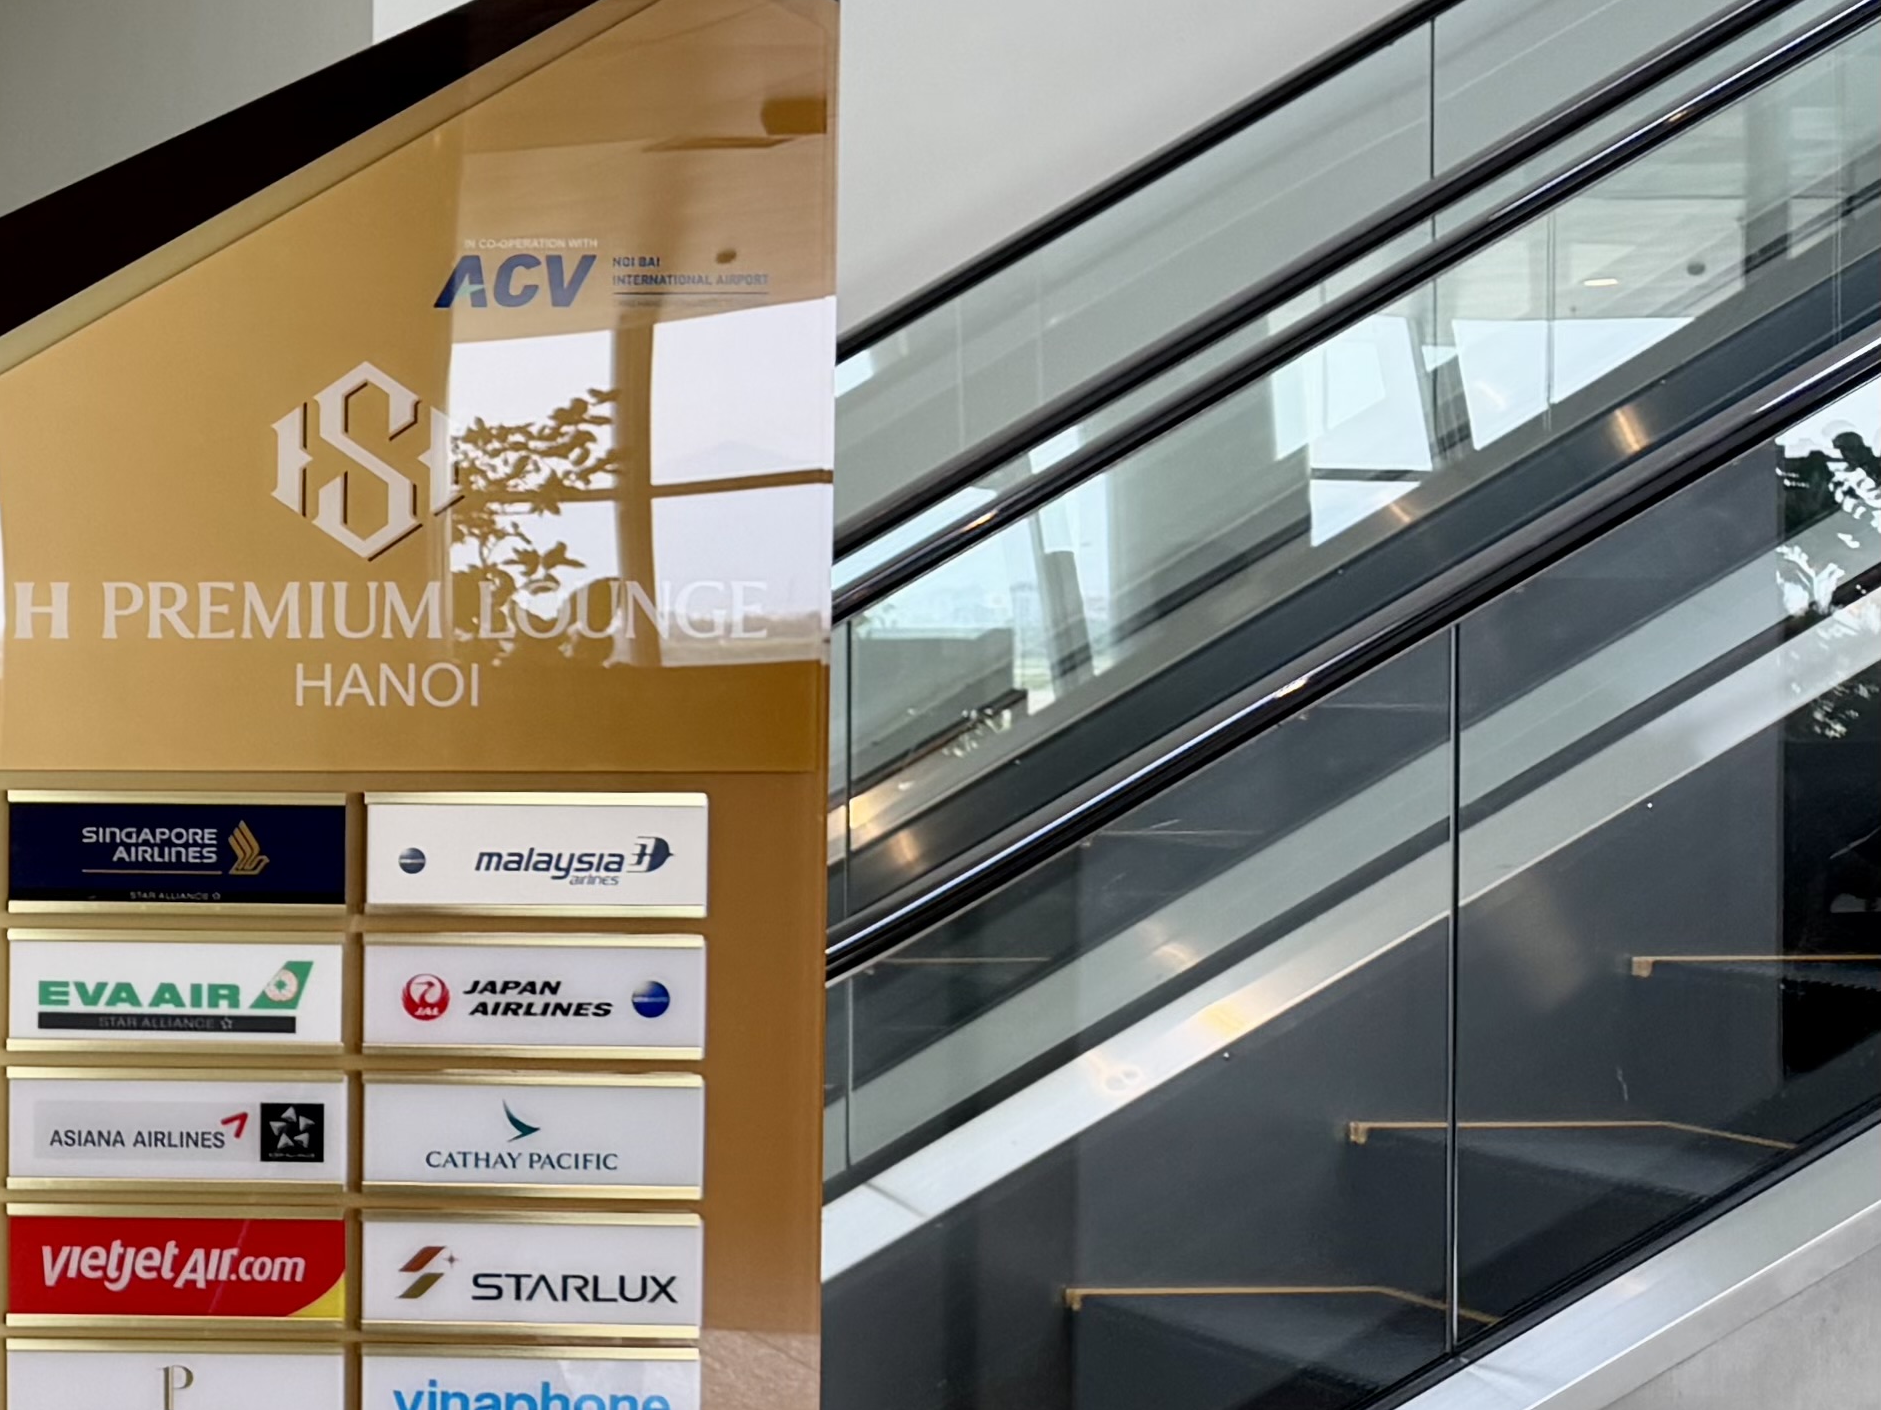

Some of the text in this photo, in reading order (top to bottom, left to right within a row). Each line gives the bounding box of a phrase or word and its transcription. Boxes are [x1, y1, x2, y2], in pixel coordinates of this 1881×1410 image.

[569, 238, 597, 248] WITH
[434, 254, 597, 308] ACV
[613, 274, 768, 286] INTERNATIONAL AIRPORT
[103, 581, 442, 641] PREMIUM
[480, 579, 768, 641] LOUNGE
[295, 662, 480, 708] HANOI
[82, 827, 217, 844] SINGAPORE
[112, 846, 217, 863] AIRLINES
[475, 848, 625, 880] malaysia
[569, 875, 619, 886] airlines
[463, 981, 561, 995] JAPAN
[469, 1002, 614, 1017] AIRLINES
[99, 1017, 215, 1030] STAR ALLIANCE
[50, 1130, 226, 1149] ASIANA AIRLINES
[425, 1151, 618, 1170] CATHAY PACIFIC
[471, 1273, 678, 1304] STARLUX
